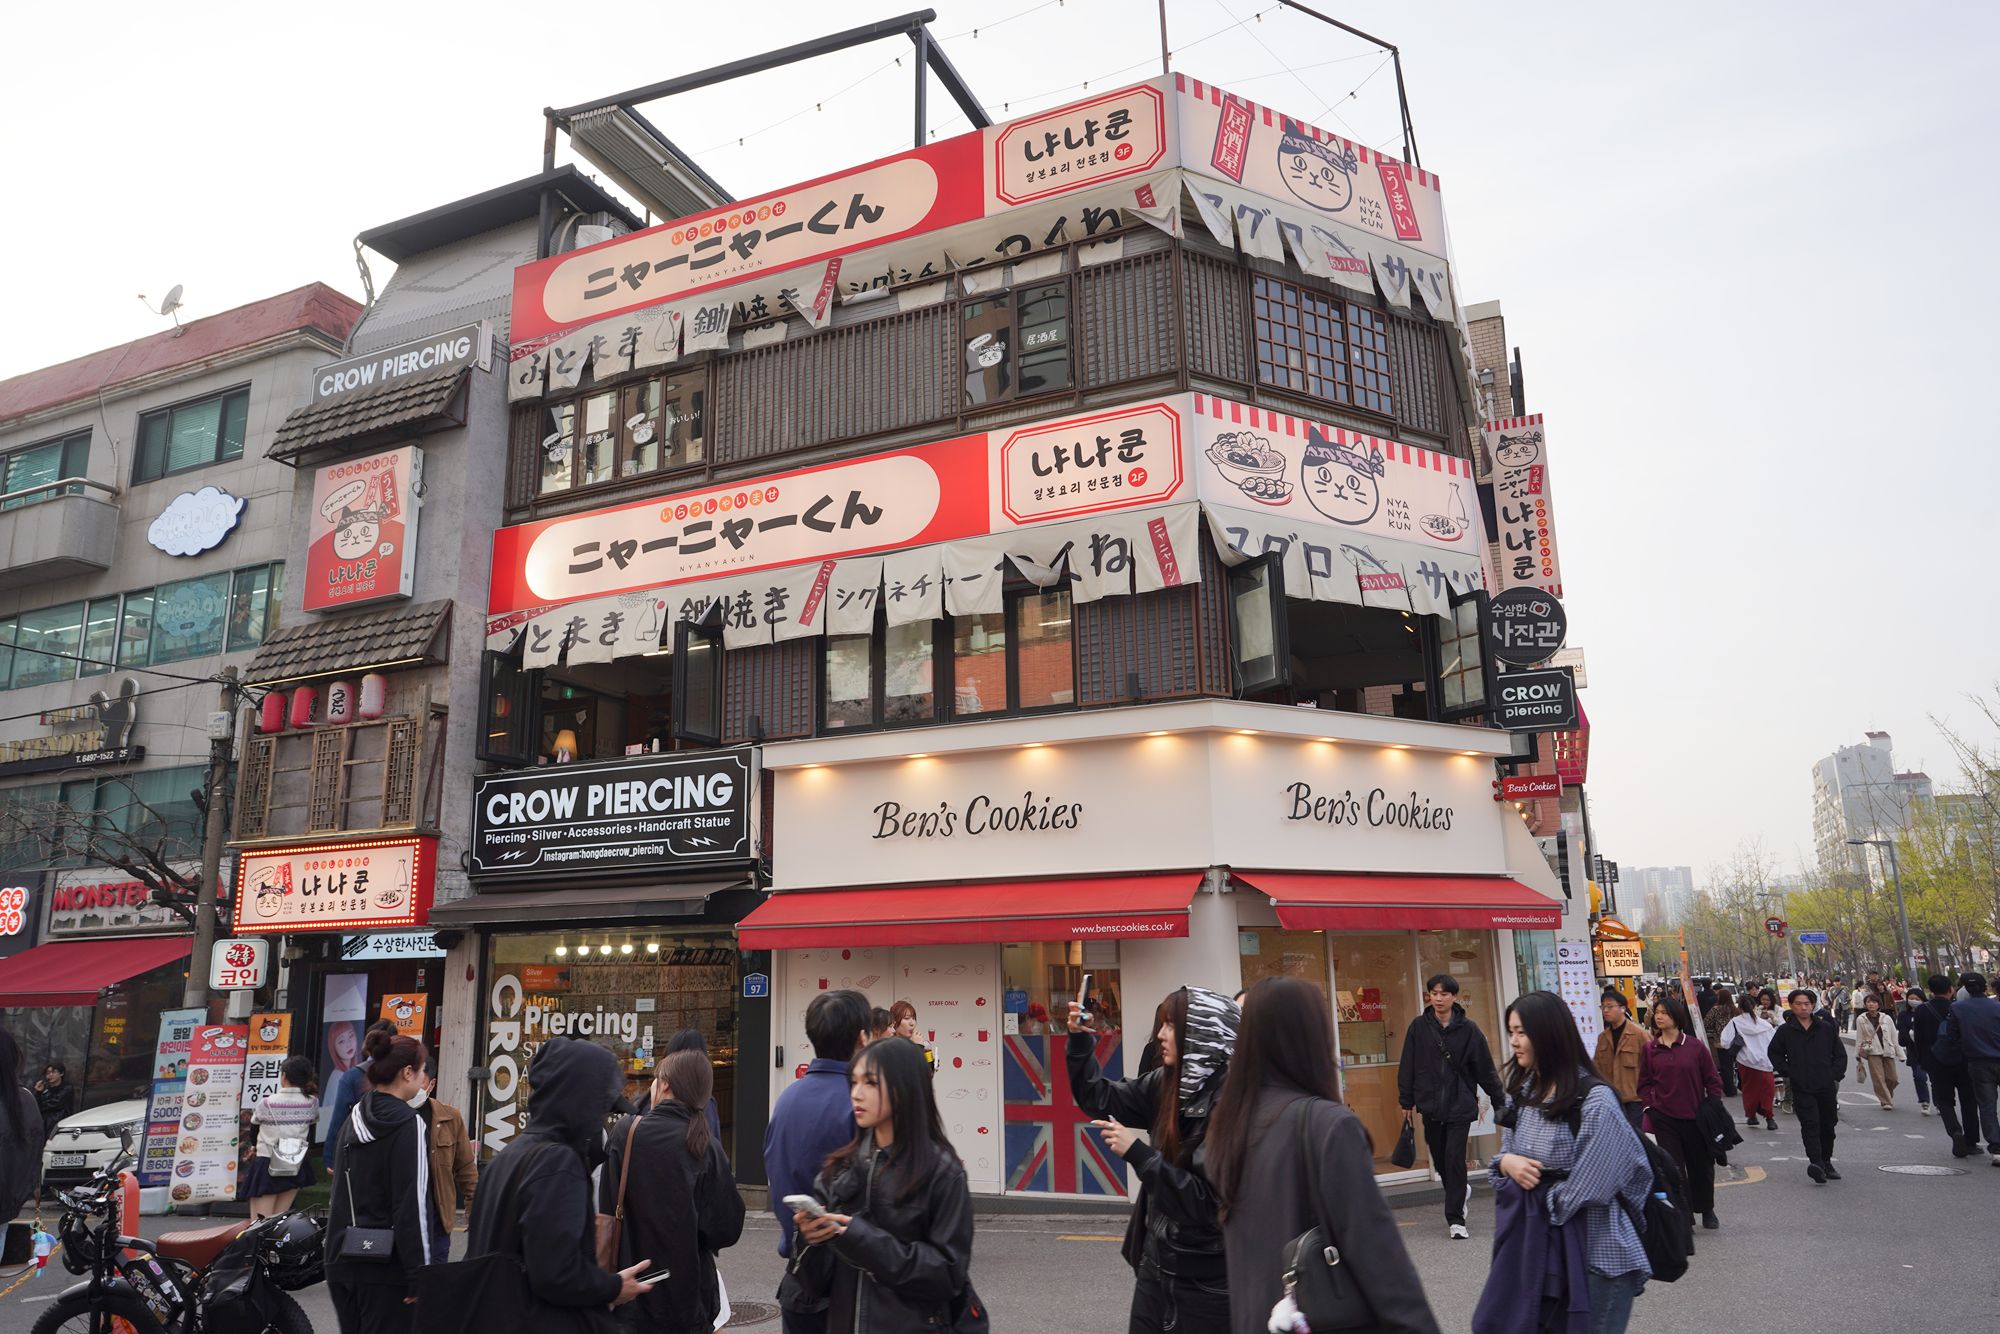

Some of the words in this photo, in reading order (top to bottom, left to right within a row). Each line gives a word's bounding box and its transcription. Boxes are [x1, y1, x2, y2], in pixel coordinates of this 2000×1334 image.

[1024, 108, 1132, 162] 냐냐쿤
[1215, 107, 1246, 174] 居酒屋
[1025, 162, 1071, 183] 일본요리
[1076, 150, 1110, 170] 전문점
[1359, 196, 1381, 210] NYA
[1385, 170, 1414, 231] うまい
[1360, 206, 1383, 220] NYA
[671, 201, 786, 246] いらっしゃいませ
[1361, 217, 1383, 230] KUN
[584, 193, 885, 300] ニャーニャーくん
[690, 259, 764, 284] NYANYAKUN
[1027, 329, 1057, 345] 居酒屋
[319, 362, 378, 396] CROW
[382, 336, 470, 380] PIERCING
[1032, 428, 1147, 477] 냐냐쿤
[1034, 481, 1081, 500] 일본요리
[1087, 474, 1122, 491] 전문점
[1131, 471, 1145, 484] 2F
[660, 486, 779, 524] いらっしゃいませ
[1387, 497, 1409, 510] NYA
[1387, 508, 1410, 520] NYA
[568, 490, 883, 575] ニャーニャーくん
[1388, 520, 1411, 532] KUN
[1503, 502, 1537, 580] 냐냐쿤
[329, 559, 376, 584] 냐냐쿤
[679, 554, 756, 572] NYANYAKUN
[1491, 603, 1528, 617] 수상한
[1492, 620, 1560, 647] 사진관
[1502, 683, 1561, 701] CROW
[1505, 703, 1562, 718] piercing
[1507, 782, 1528, 792] Ben's
[1529, 778, 1557, 791] Cookies
[486, 786, 579, 826] CROW
[587, 772, 733, 817] PIERCING
[1286, 782, 1361, 825] Ben's
[1366, 788, 1454, 831] Cookies
[694, 815, 731, 829] Statue
[872, 801, 957, 838] Ben's
[965, 791, 1083, 835] Cookies
[544, 844, 664, 862] Instagram:hongdaecrow_piercing
[302, 870, 369, 896] 냐냐쿤
[300, 901, 335, 914] 일본요리
[340, 899, 367, 911] 전문점
[1072, 921, 1174, 934] www.benscookies.co.kr
[1492, 914, 1556, 925] www.benscookies.co.kr
[1605, 949, 1639, 958] 아메리카노
[1607, 959, 1639, 968] 1,500원
[218, 969, 257, 987] 코인
[750, 984, 761, 994] 97
[524, 1005, 638, 1043] Piercing
[173, 1027, 191, 1040] 평일
[484, 974, 523, 1152] CROW
